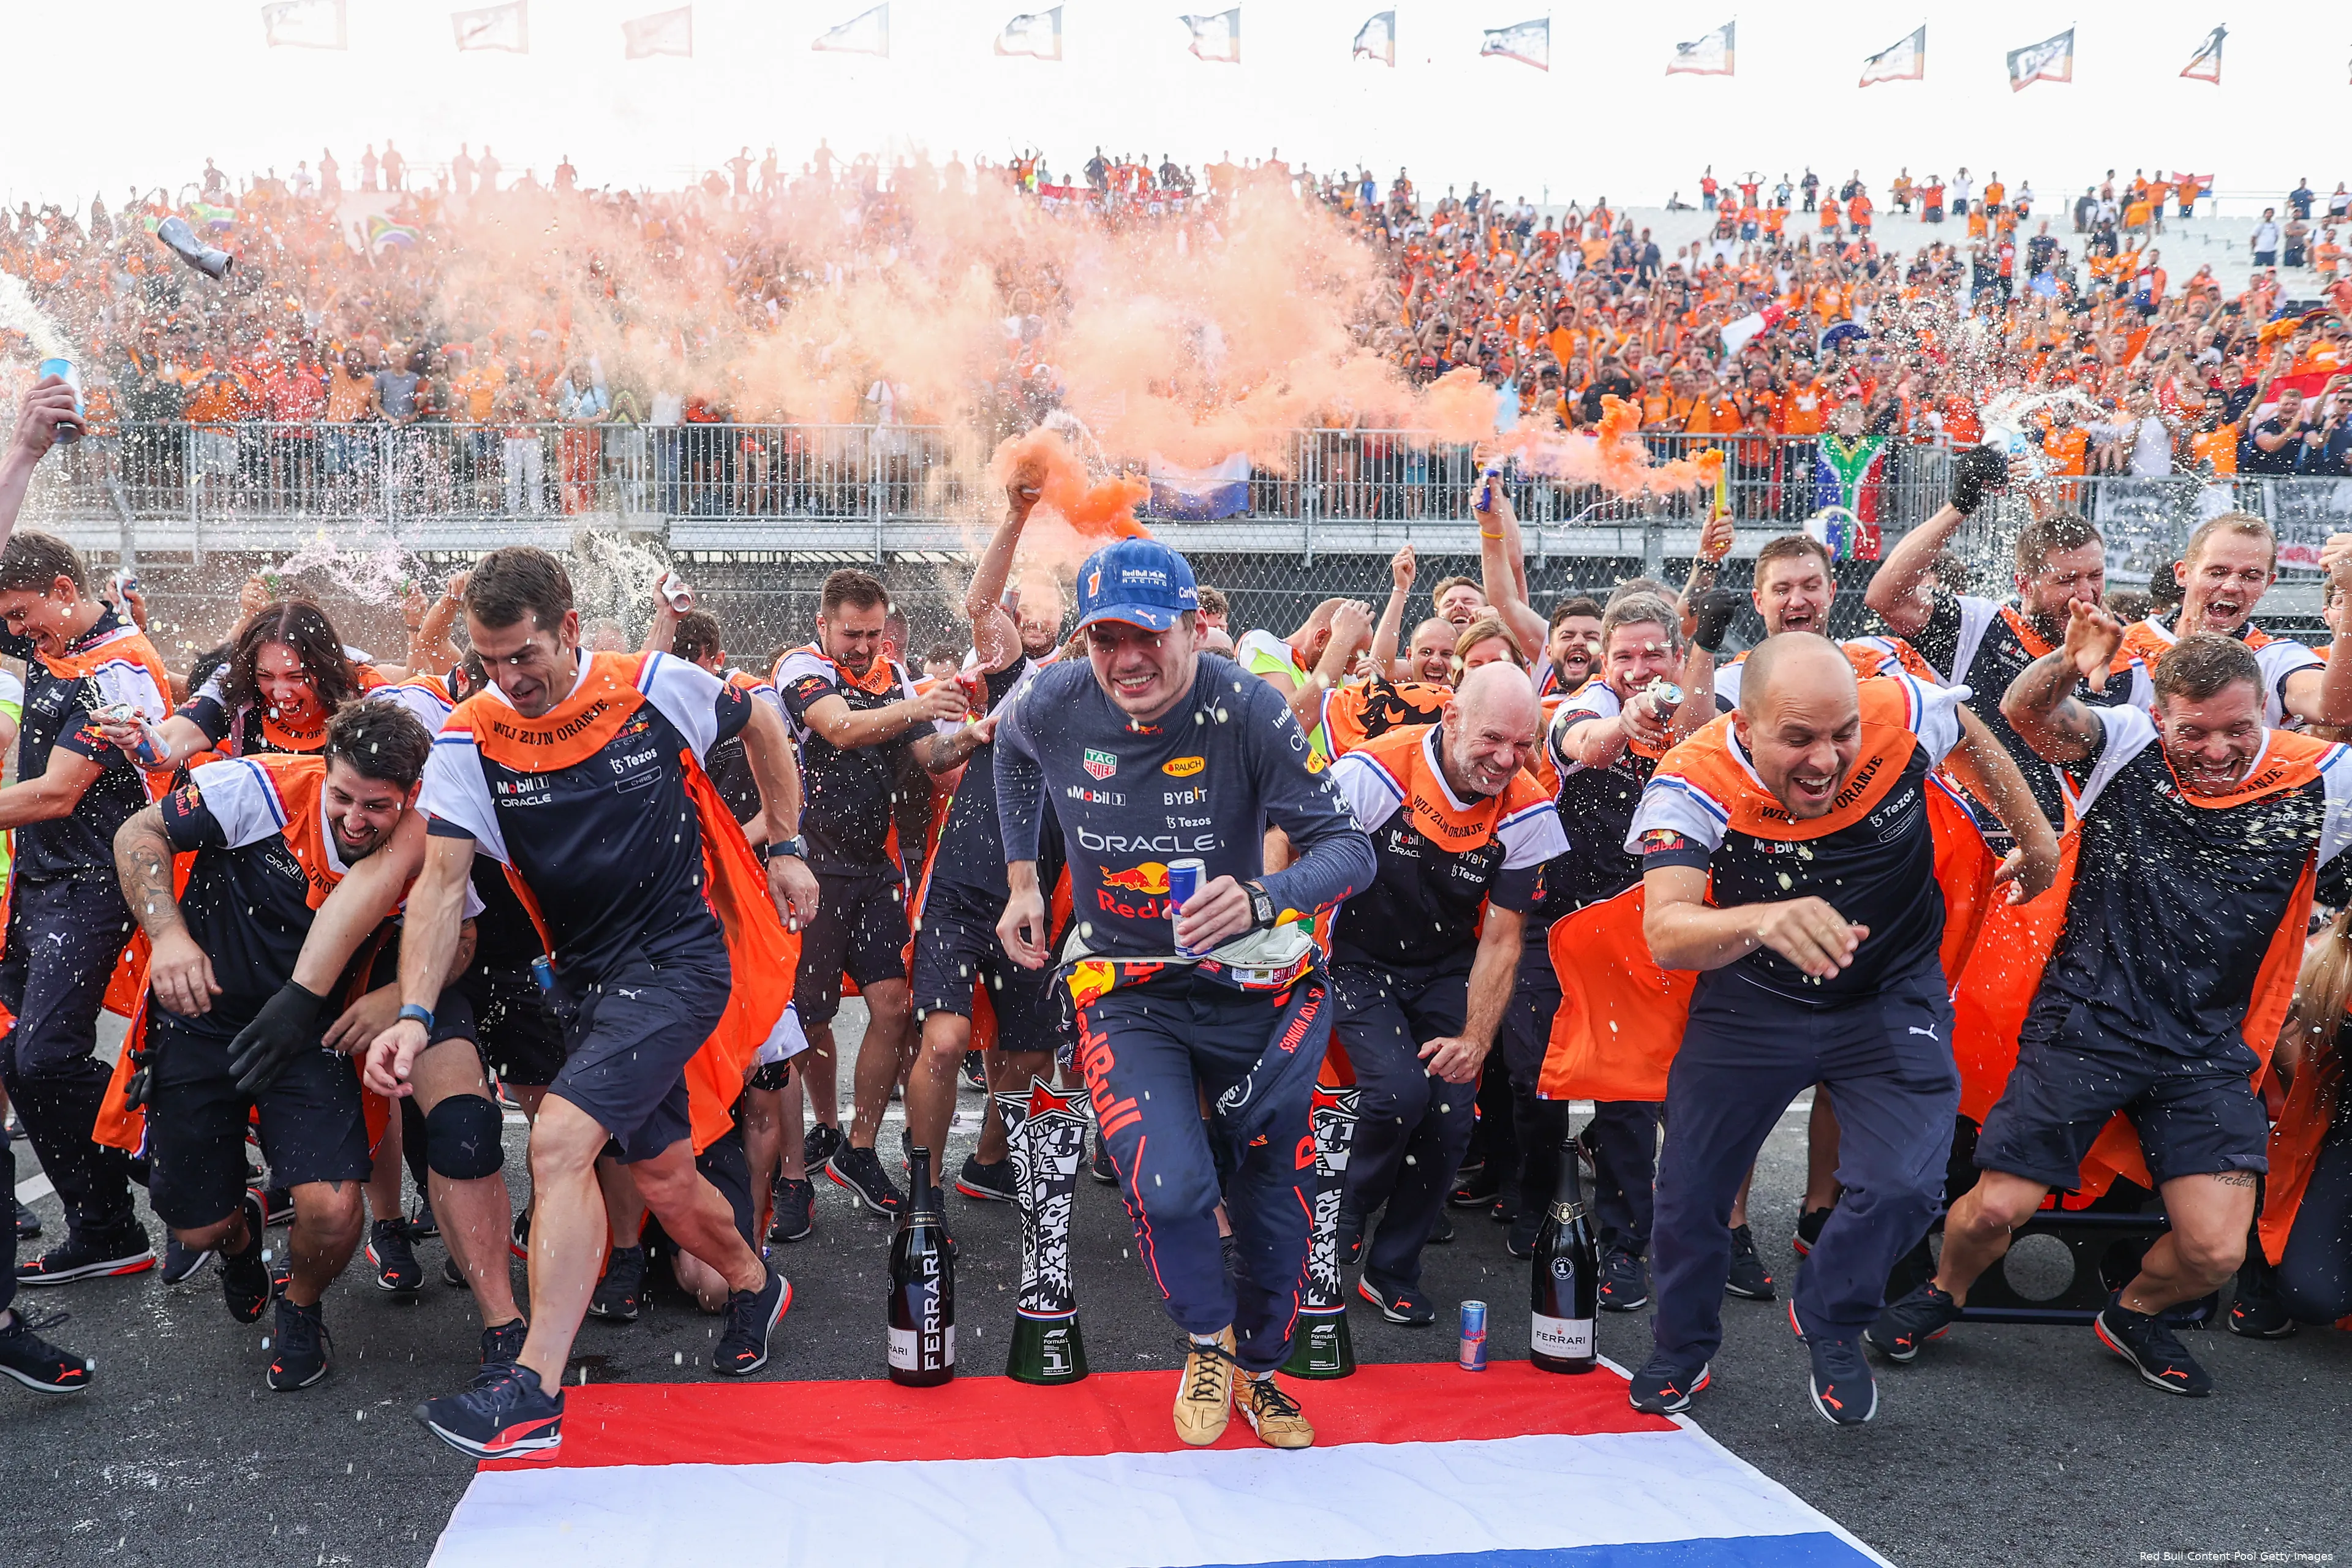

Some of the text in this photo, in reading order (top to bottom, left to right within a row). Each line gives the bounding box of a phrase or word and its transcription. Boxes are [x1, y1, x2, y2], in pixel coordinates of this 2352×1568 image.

[1088, 570, 1101, 598] 1
[1123, 578, 1167, 587] RACING
[493, 698, 609, 746] WIJ ZIJN ORANJE
[622, 747, 658, 769] Tezos
[1087, 750, 1115, 764] TAG
[1174, 760, 1202, 772] RAUCH
[1085, 761, 1115, 777] HEUER
[496, 777, 535, 795] Mobil
[630, 774, 652, 786] CHRIS
[1835, 755, 1884, 809] ORANJE
[501, 793, 552, 808] ORACLE
[1072, 785, 1110, 805] Mobil
[1164, 786, 1207, 806] BYBIT
[1882, 786, 1915, 818] Tezos
[176, 797, 189, 817] Bull
[1412, 794, 1433, 815] WIJ
[1448, 822, 1485, 838] ORANJE
[1178, 816, 1212, 827] Tezos
[1079, 832, 1216, 853] ORACLE
[1392, 829, 1419, 846] Mobil
[1753, 838, 1795, 854] Mobil
[1388, 845, 1422, 858] ORACL
[1458, 851, 1489, 869] BYBIT
[1096, 888, 1159, 919] Red
[1279, 1017, 1310, 1054] WINGS
[1084, 1043, 1143, 1141] Bull
[1558, 1263, 1567, 1274] 1
[922, 1248, 940, 1372] FERRARI
[1536, 1330, 1586, 1345] FERRARI
